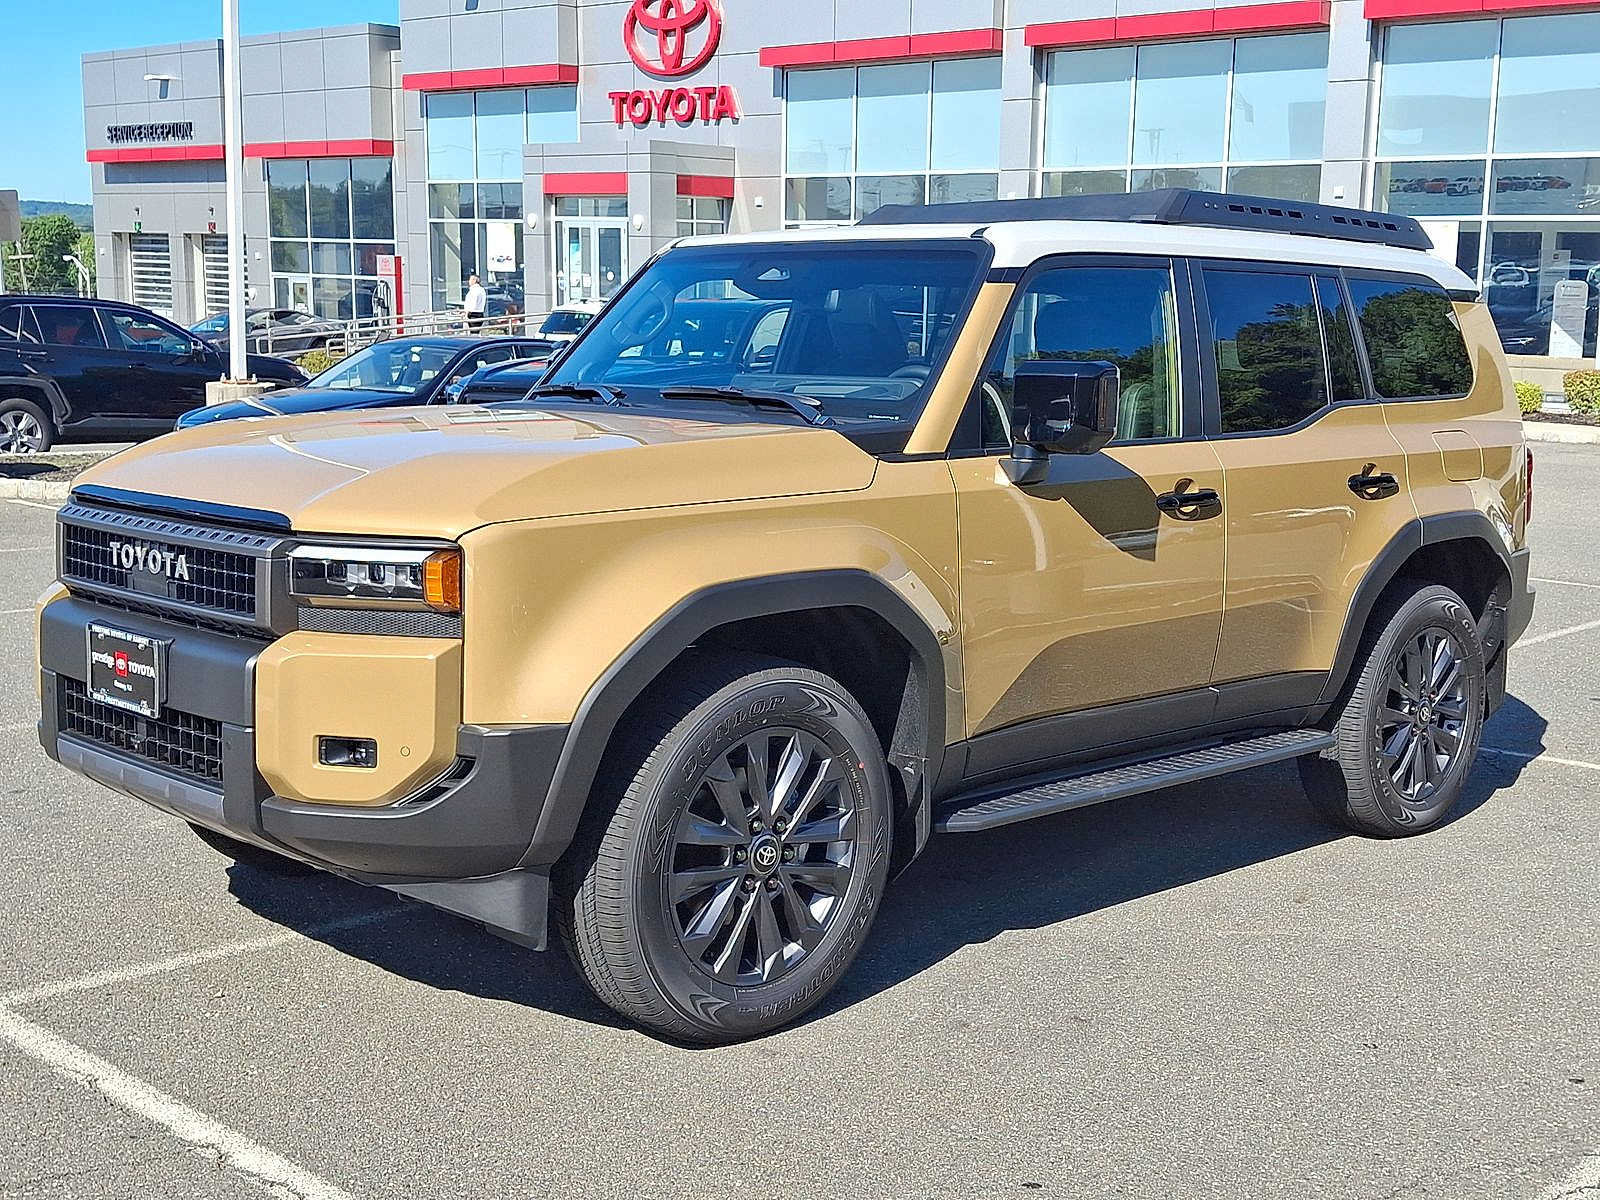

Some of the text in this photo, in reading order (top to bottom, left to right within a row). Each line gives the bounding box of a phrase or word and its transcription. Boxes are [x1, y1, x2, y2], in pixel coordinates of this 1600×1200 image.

[608, 85, 741, 127] TOYOTA
[107, 121, 193, 143] SERVICE RECEPTION
[109, 541, 189, 580] TOYOTA
[127, 661, 156, 679] TOYOTA
[682, 695, 786, 782] DUNLOP
